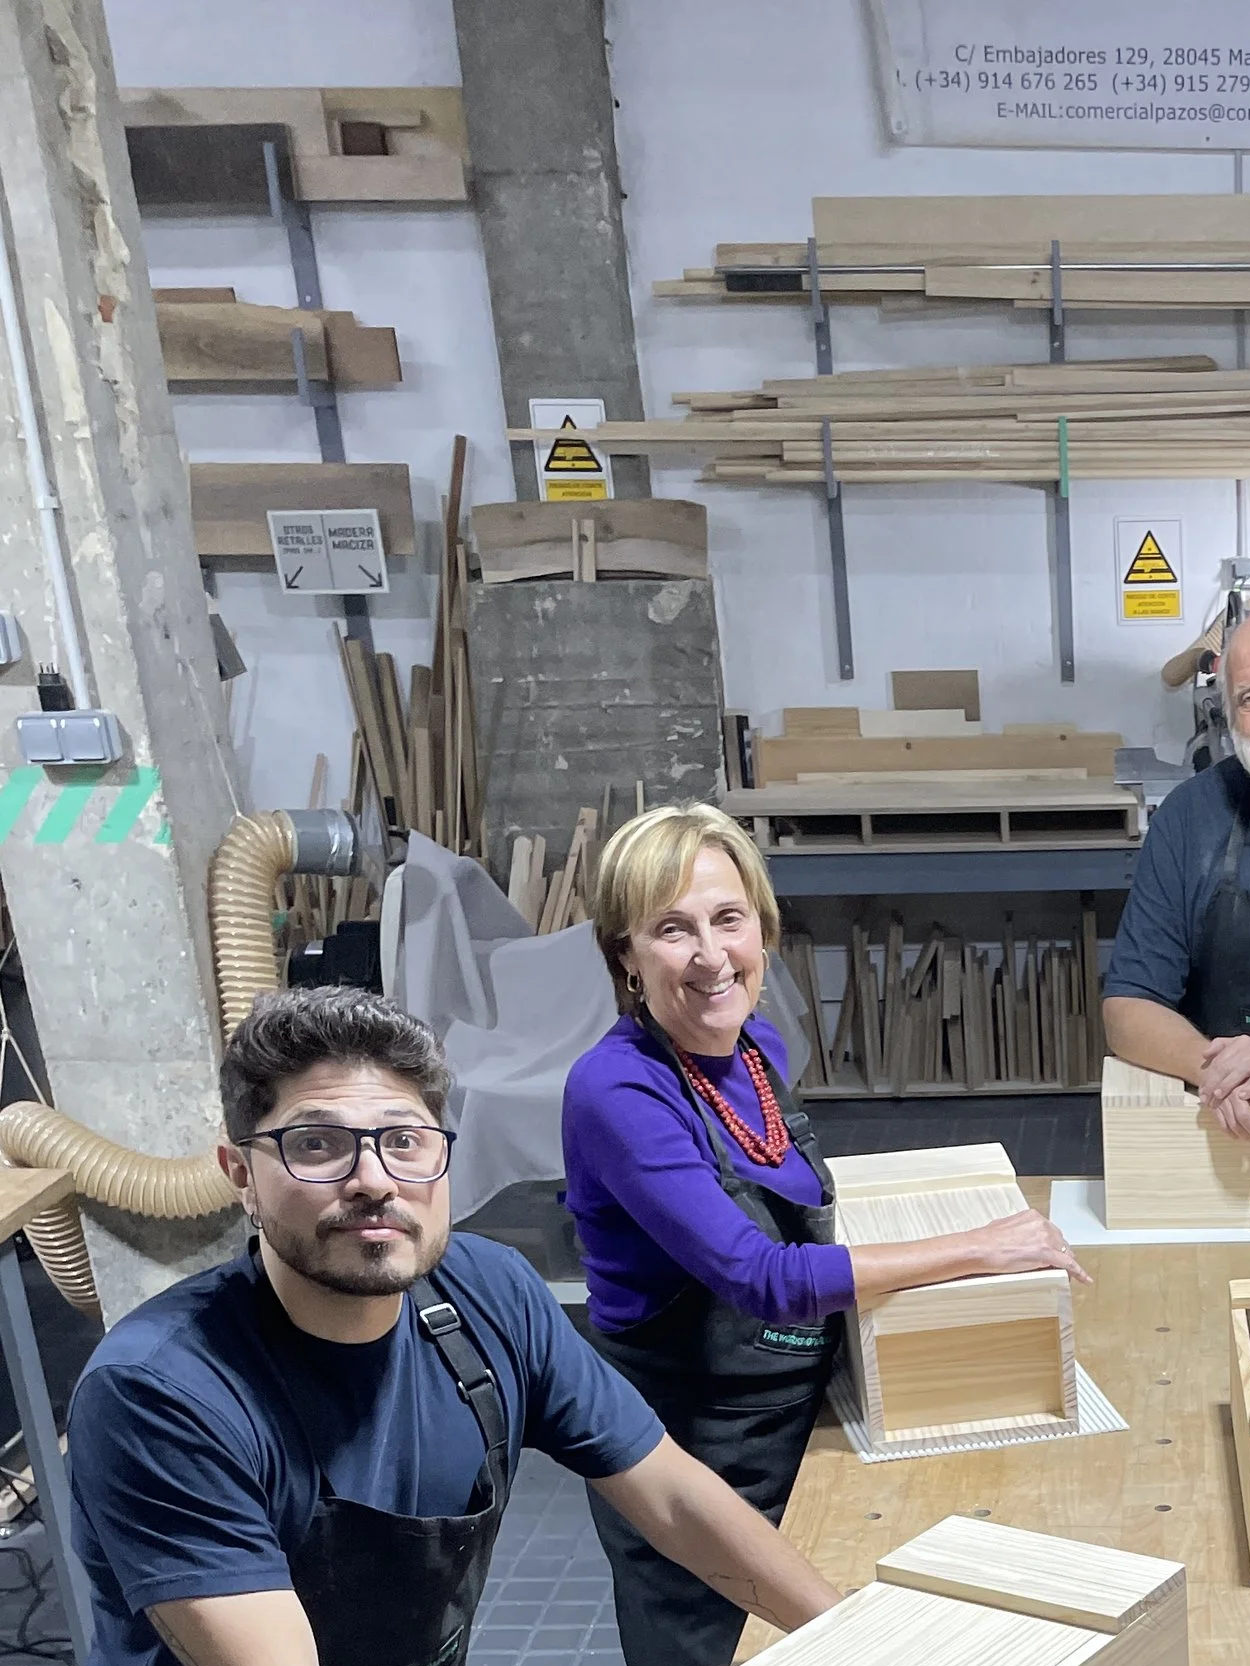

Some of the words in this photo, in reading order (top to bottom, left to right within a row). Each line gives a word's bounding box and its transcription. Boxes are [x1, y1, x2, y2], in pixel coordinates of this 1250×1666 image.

[954, 44, 976, 65] C/
[983, 45, 1107, 68] Embajadores
[1115, 47, 1155, 69] 129,
[1162, 47, 1221, 66] 28045
[915, 70, 971, 93] (+34)
[977, 71, 1013, 90] 914
[1020, 72, 1056, 91] 676
[1063, 73, 1098, 91] 265
[1111, 72, 1167, 95] (+34)
[1173, 74, 1209, 92] 915
[1216, 74, 1250, 93] 279
[328, 526, 375, 538] MADERA
[332, 539, 375, 550] MACIZA
